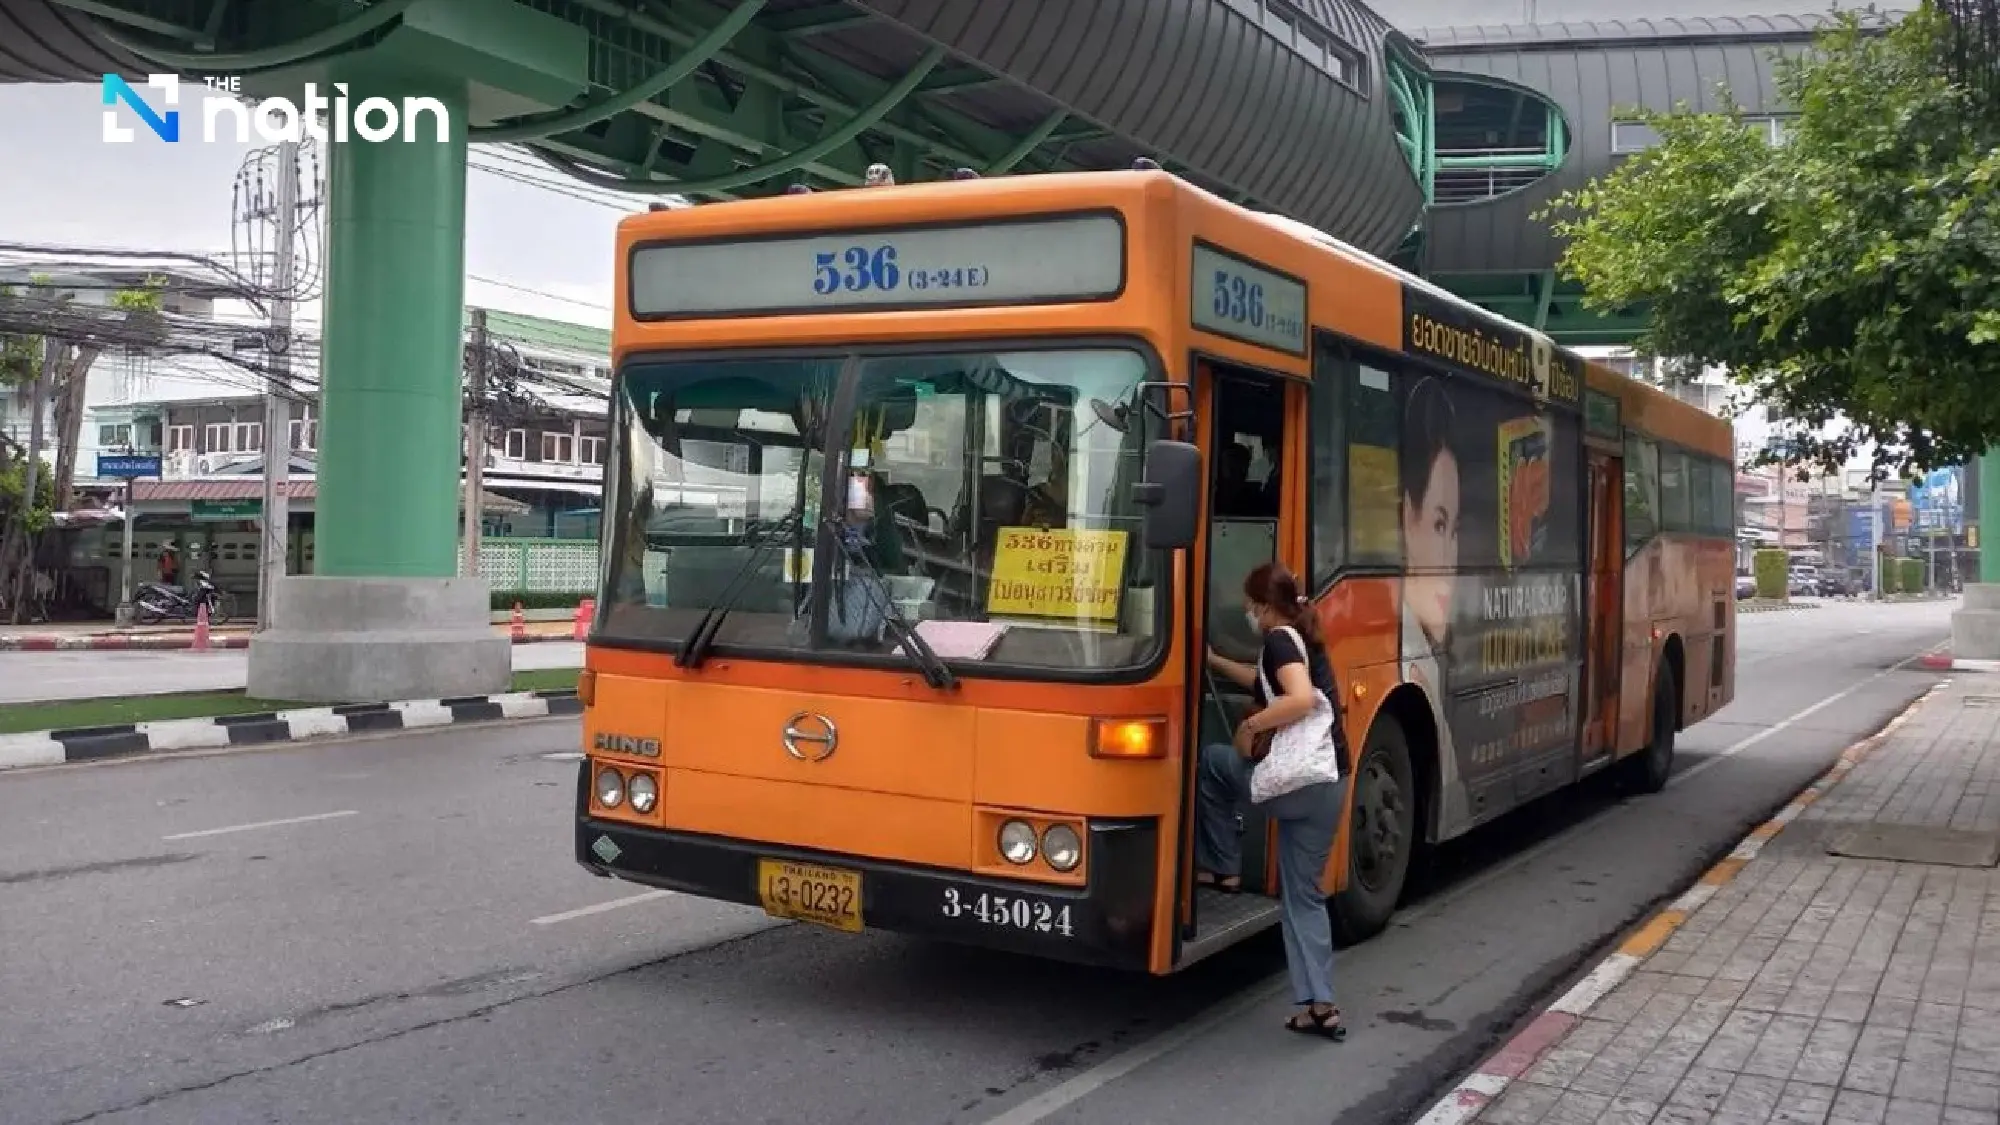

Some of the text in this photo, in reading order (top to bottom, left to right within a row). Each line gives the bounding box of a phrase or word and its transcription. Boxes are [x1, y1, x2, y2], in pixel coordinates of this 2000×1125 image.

[814, 245, 899, 295] 536
[1214, 270, 1263, 328] 536
[783, 864, 837, 881] THAILAND
[942, 887, 1075, 937] 3-45024
